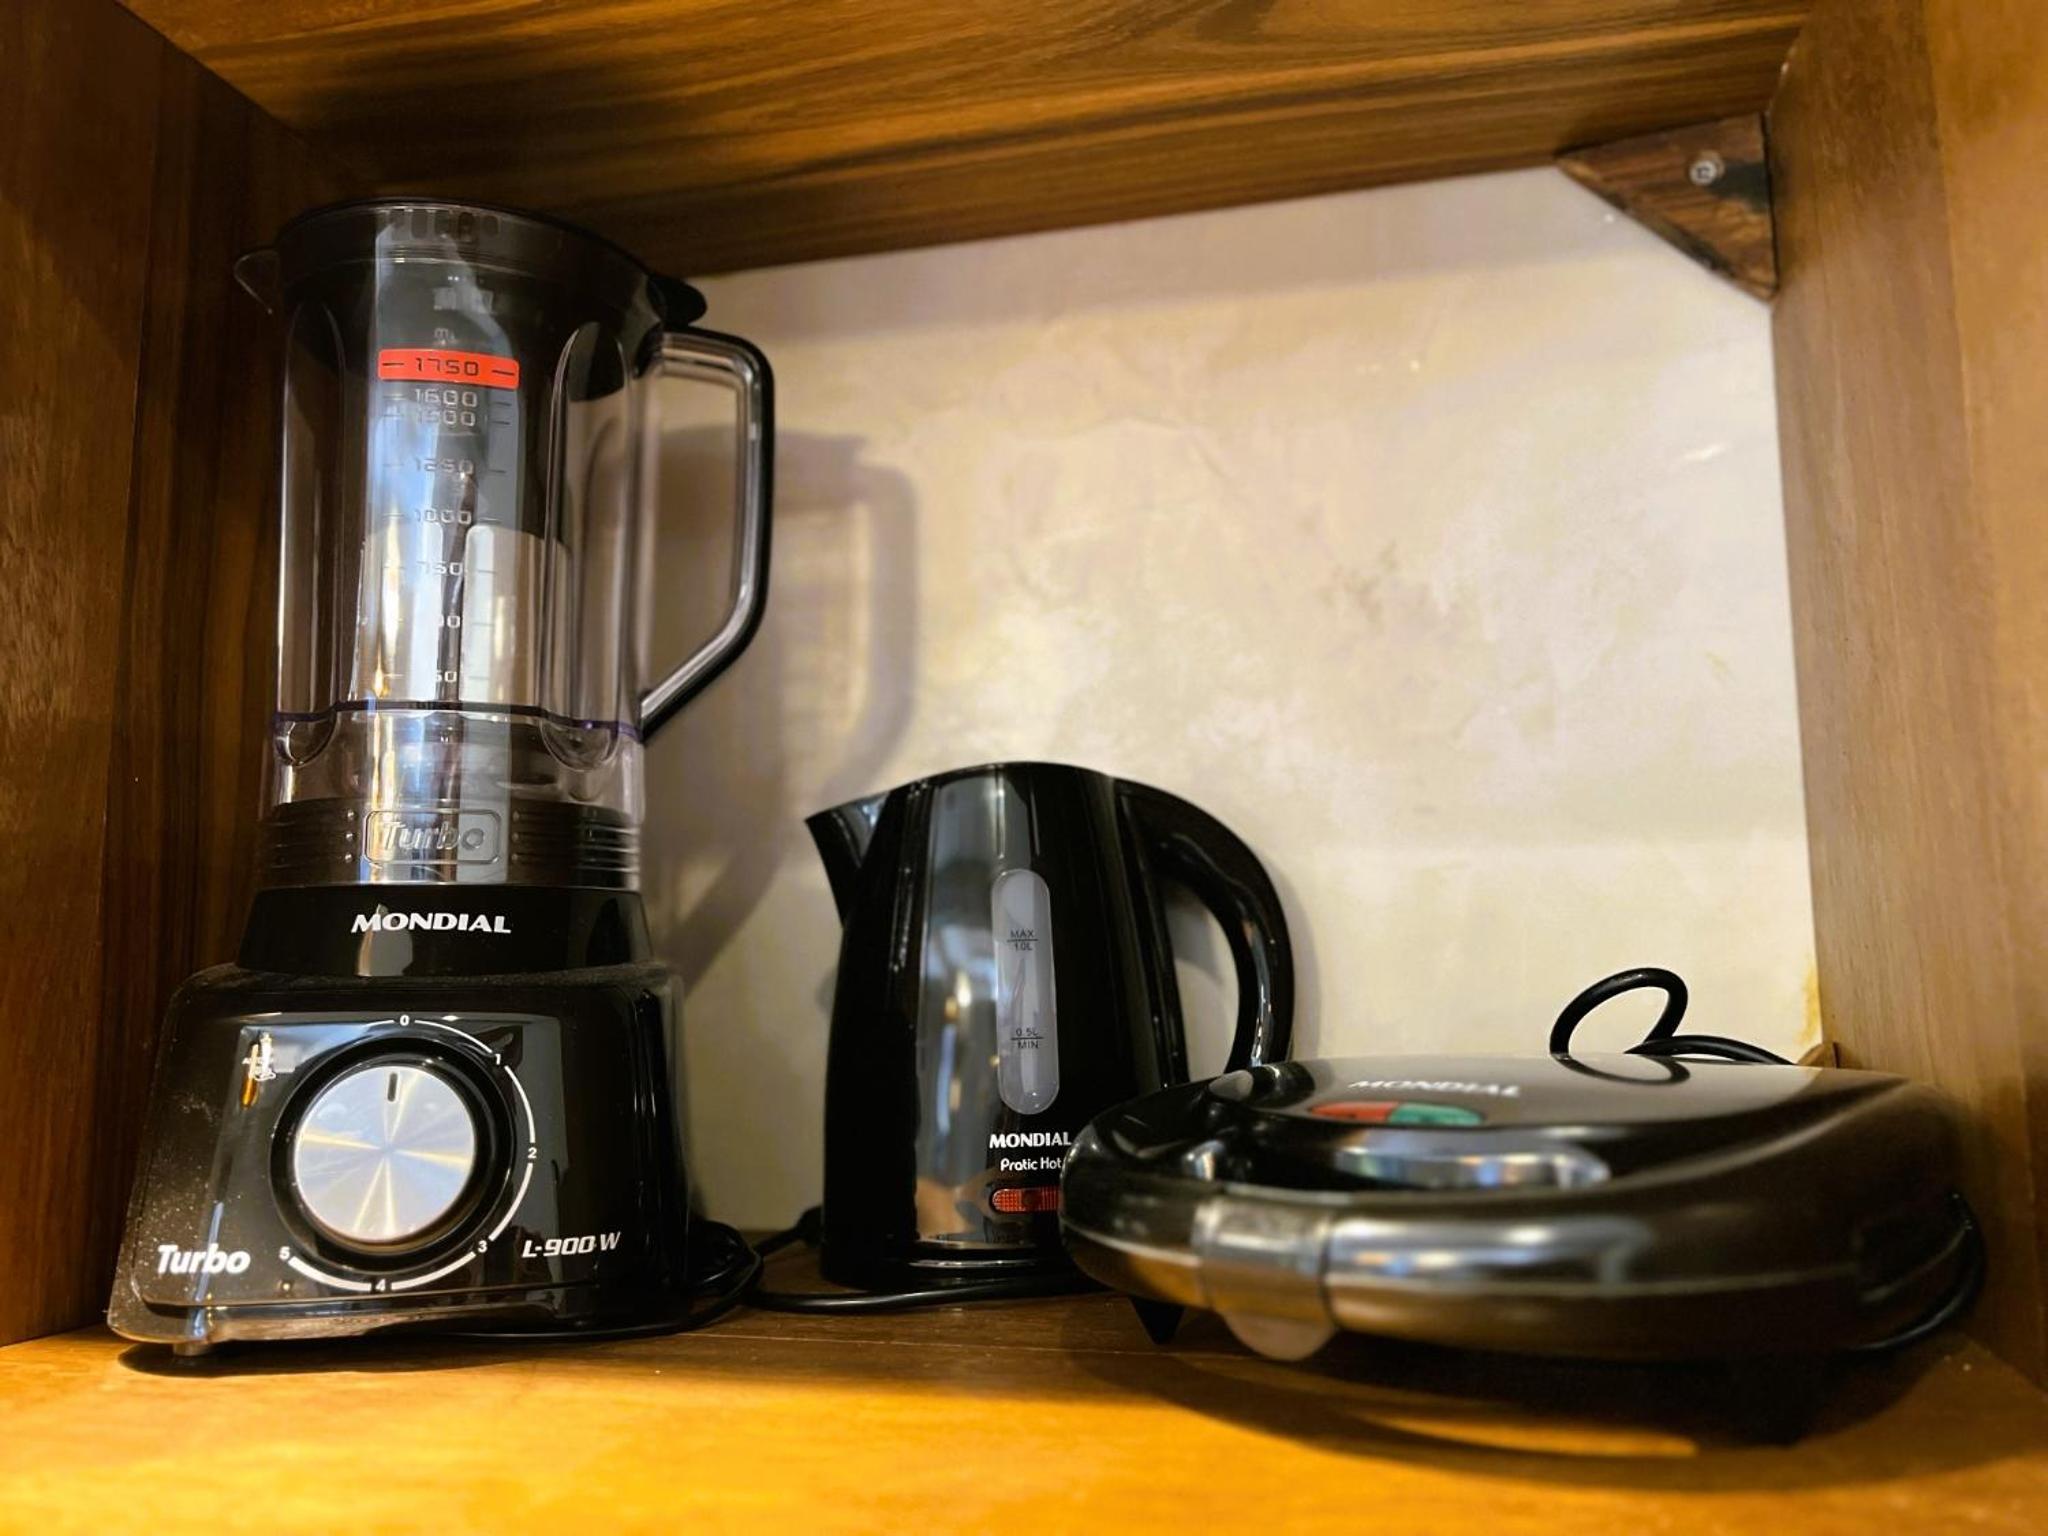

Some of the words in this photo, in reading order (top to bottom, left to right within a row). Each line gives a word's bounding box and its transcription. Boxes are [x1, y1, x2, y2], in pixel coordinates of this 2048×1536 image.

[415, 357, 479, 376] 1750
[414, 388, 478, 408] 1600
[414, 457, 474, 475] 1250
[414, 509, 472, 525] 1000
[382, 821, 486, 851] Turbo
[351, 911, 512, 934] MONDIAL
[1010, 929, 1035, 939] MAX
[400, 1014, 410, 1026] 0
[1017, 1040, 1039, 1050] MIN
[494, 1053, 501, 1065] 1
[1349, 1080, 1521, 1098] MONDIAL
[989, 1131, 1072, 1149] MONDIAL
[527, 1146, 538, 1159] 2
[1040, 1156, 1063, 1170] Hot
[278, 1246, 290, 1261] 5
[477, 1239, 488, 1253] 3
[157, 1242, 252, 1274] Turbo
[375, 1279, 386, 1292] 4
